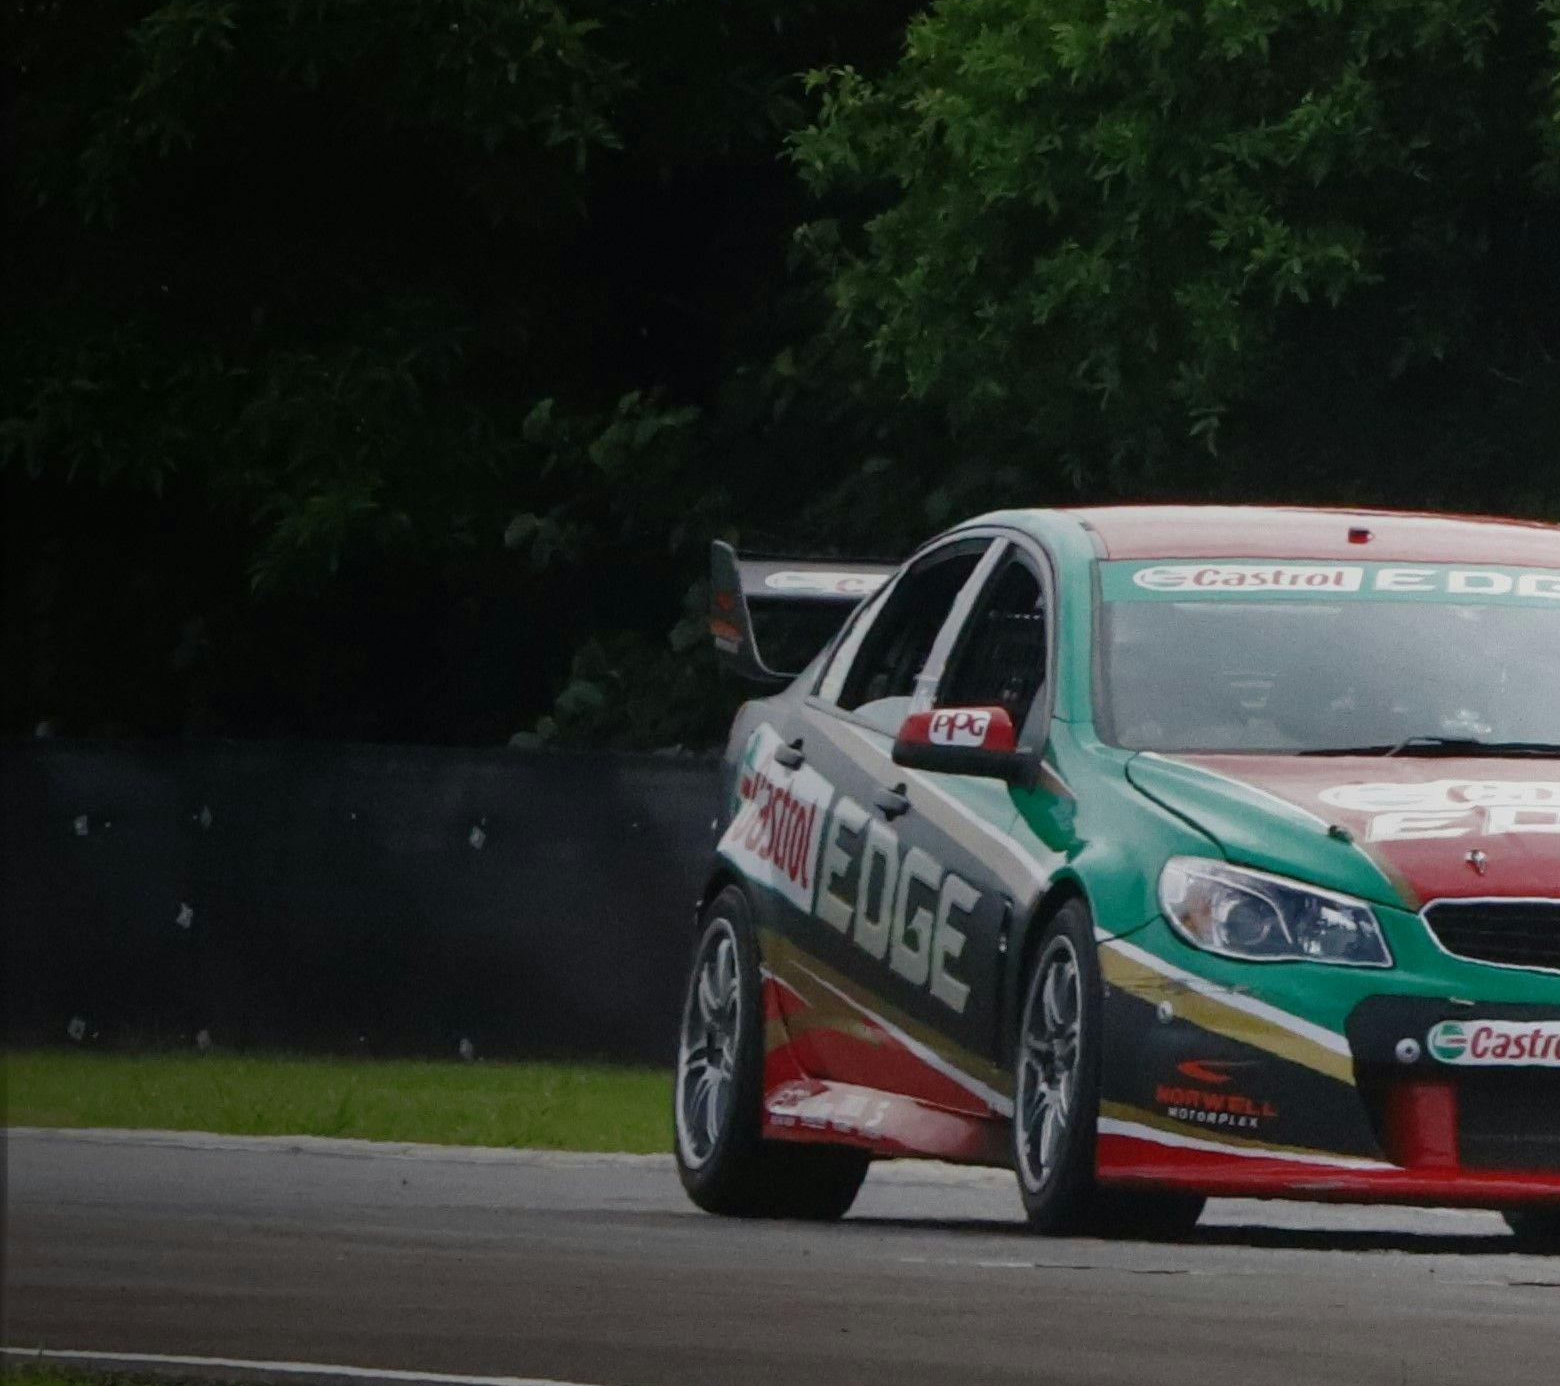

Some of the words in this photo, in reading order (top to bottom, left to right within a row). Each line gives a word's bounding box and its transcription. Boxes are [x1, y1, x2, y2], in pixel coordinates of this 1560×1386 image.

[1192, 565, 1346, 590] Castrol
[932, 713, 988, 743] PPG
[817, 796, 983, 1013] EDGE
